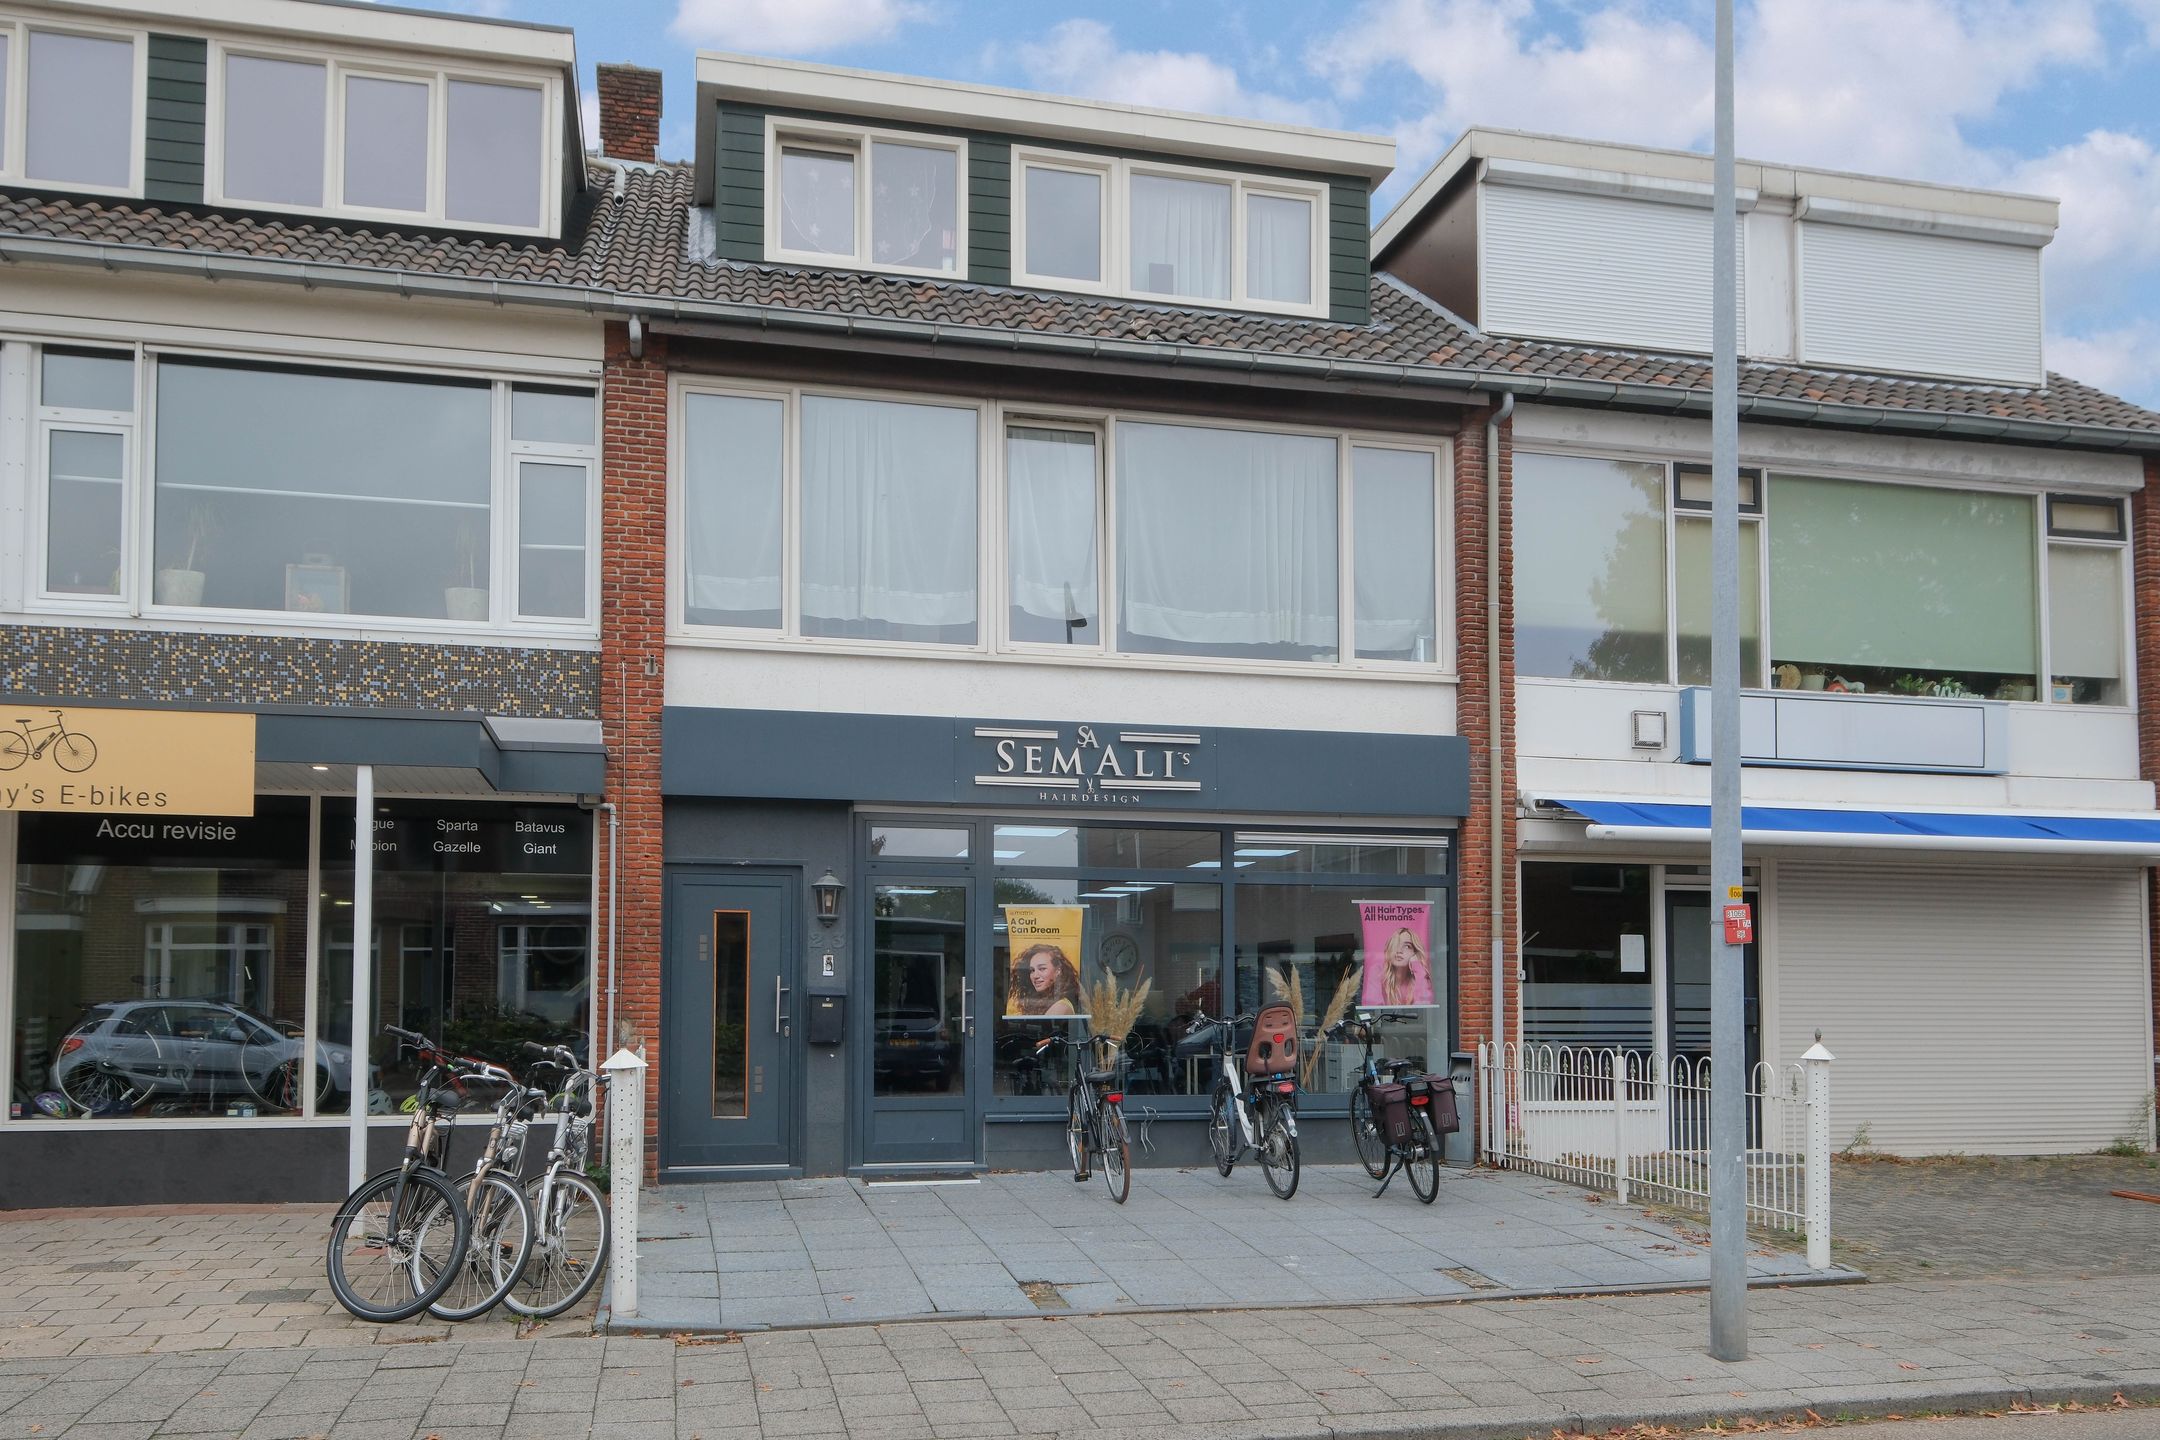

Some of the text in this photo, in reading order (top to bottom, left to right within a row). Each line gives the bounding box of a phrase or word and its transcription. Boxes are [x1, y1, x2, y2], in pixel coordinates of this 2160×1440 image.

[0, 783, 168, 808] y's E-bikes
[1039, 792, 1140, 804] HAIRDESIGN
[96, 819, 237, 841] Accu revisie
[353, 817, 395, 832] gue
[436, 819, 479, 832] Sparta
[515, 821, 566, 833] Batavus
[433, 841, 481, 853] Gazelle
[523, 842, 557, 854] Giant
[1364, 906, 1376, 914] All
[1378, 905, 1396, 913] Hair
[1364, 913, 1376, 921] All
[1011, 926, 1060, 934] Can Dream
